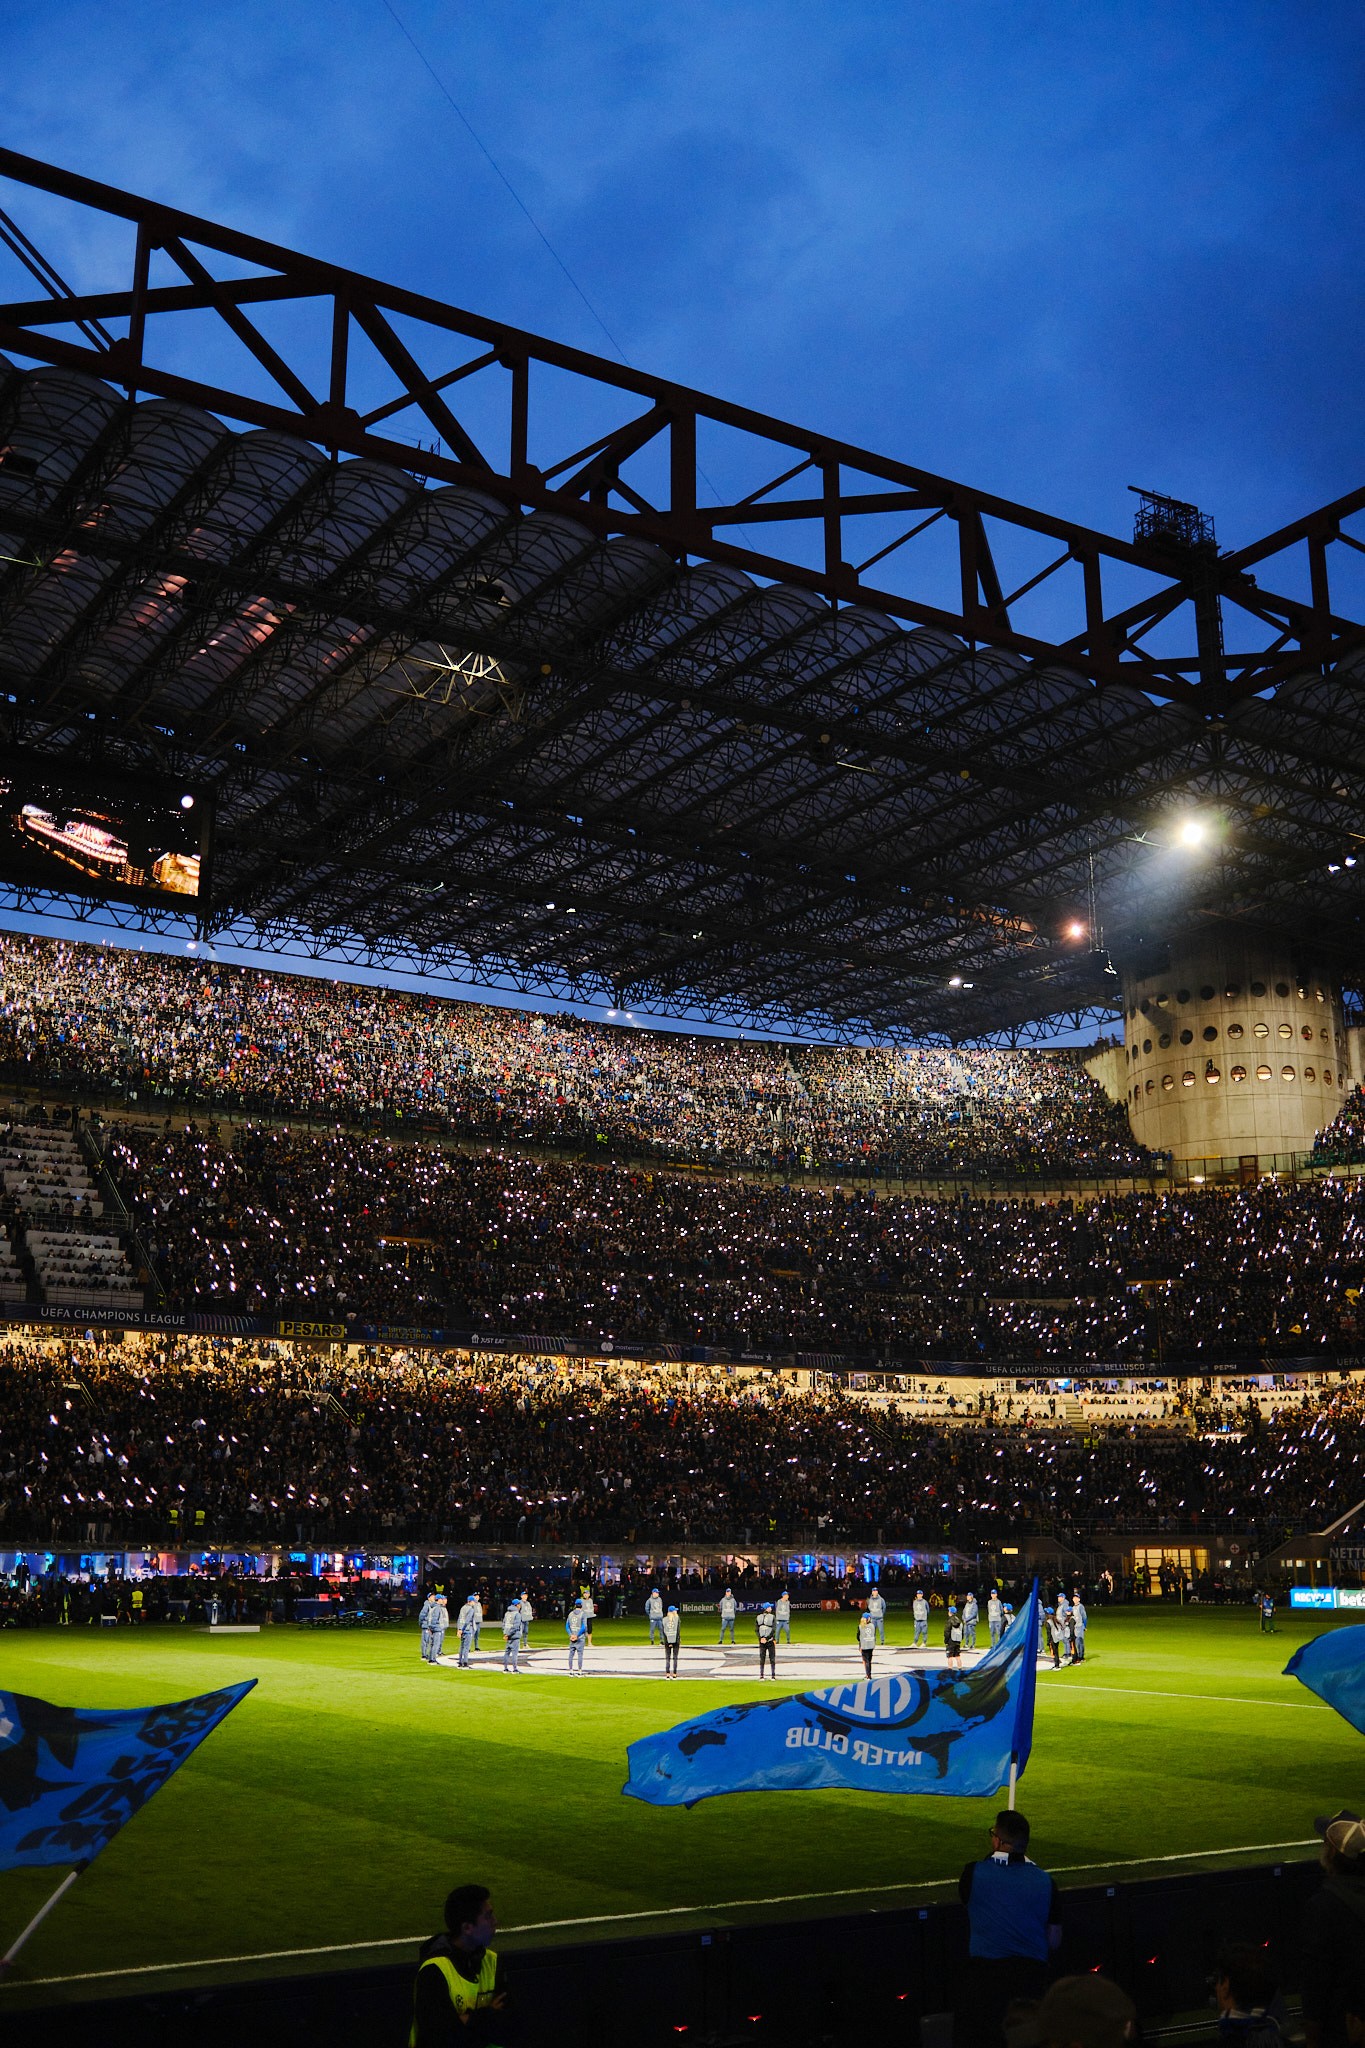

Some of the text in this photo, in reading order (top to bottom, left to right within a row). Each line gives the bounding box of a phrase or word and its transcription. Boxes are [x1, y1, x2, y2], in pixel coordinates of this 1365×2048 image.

[40, 1307, 186, 1325] UEFA CHAMPIONS LEAGUE
[884, 1360, 902, 1368] PS5
[1336, 1356, 1361, 1366] UEFA
[986, 1365, 1092, 1374] UEFA CHAMPIONS LEAGU
[1104, 1363, 1145, 1371] BELLUSCO
[682, 1603, 715, 1611] Heineken
